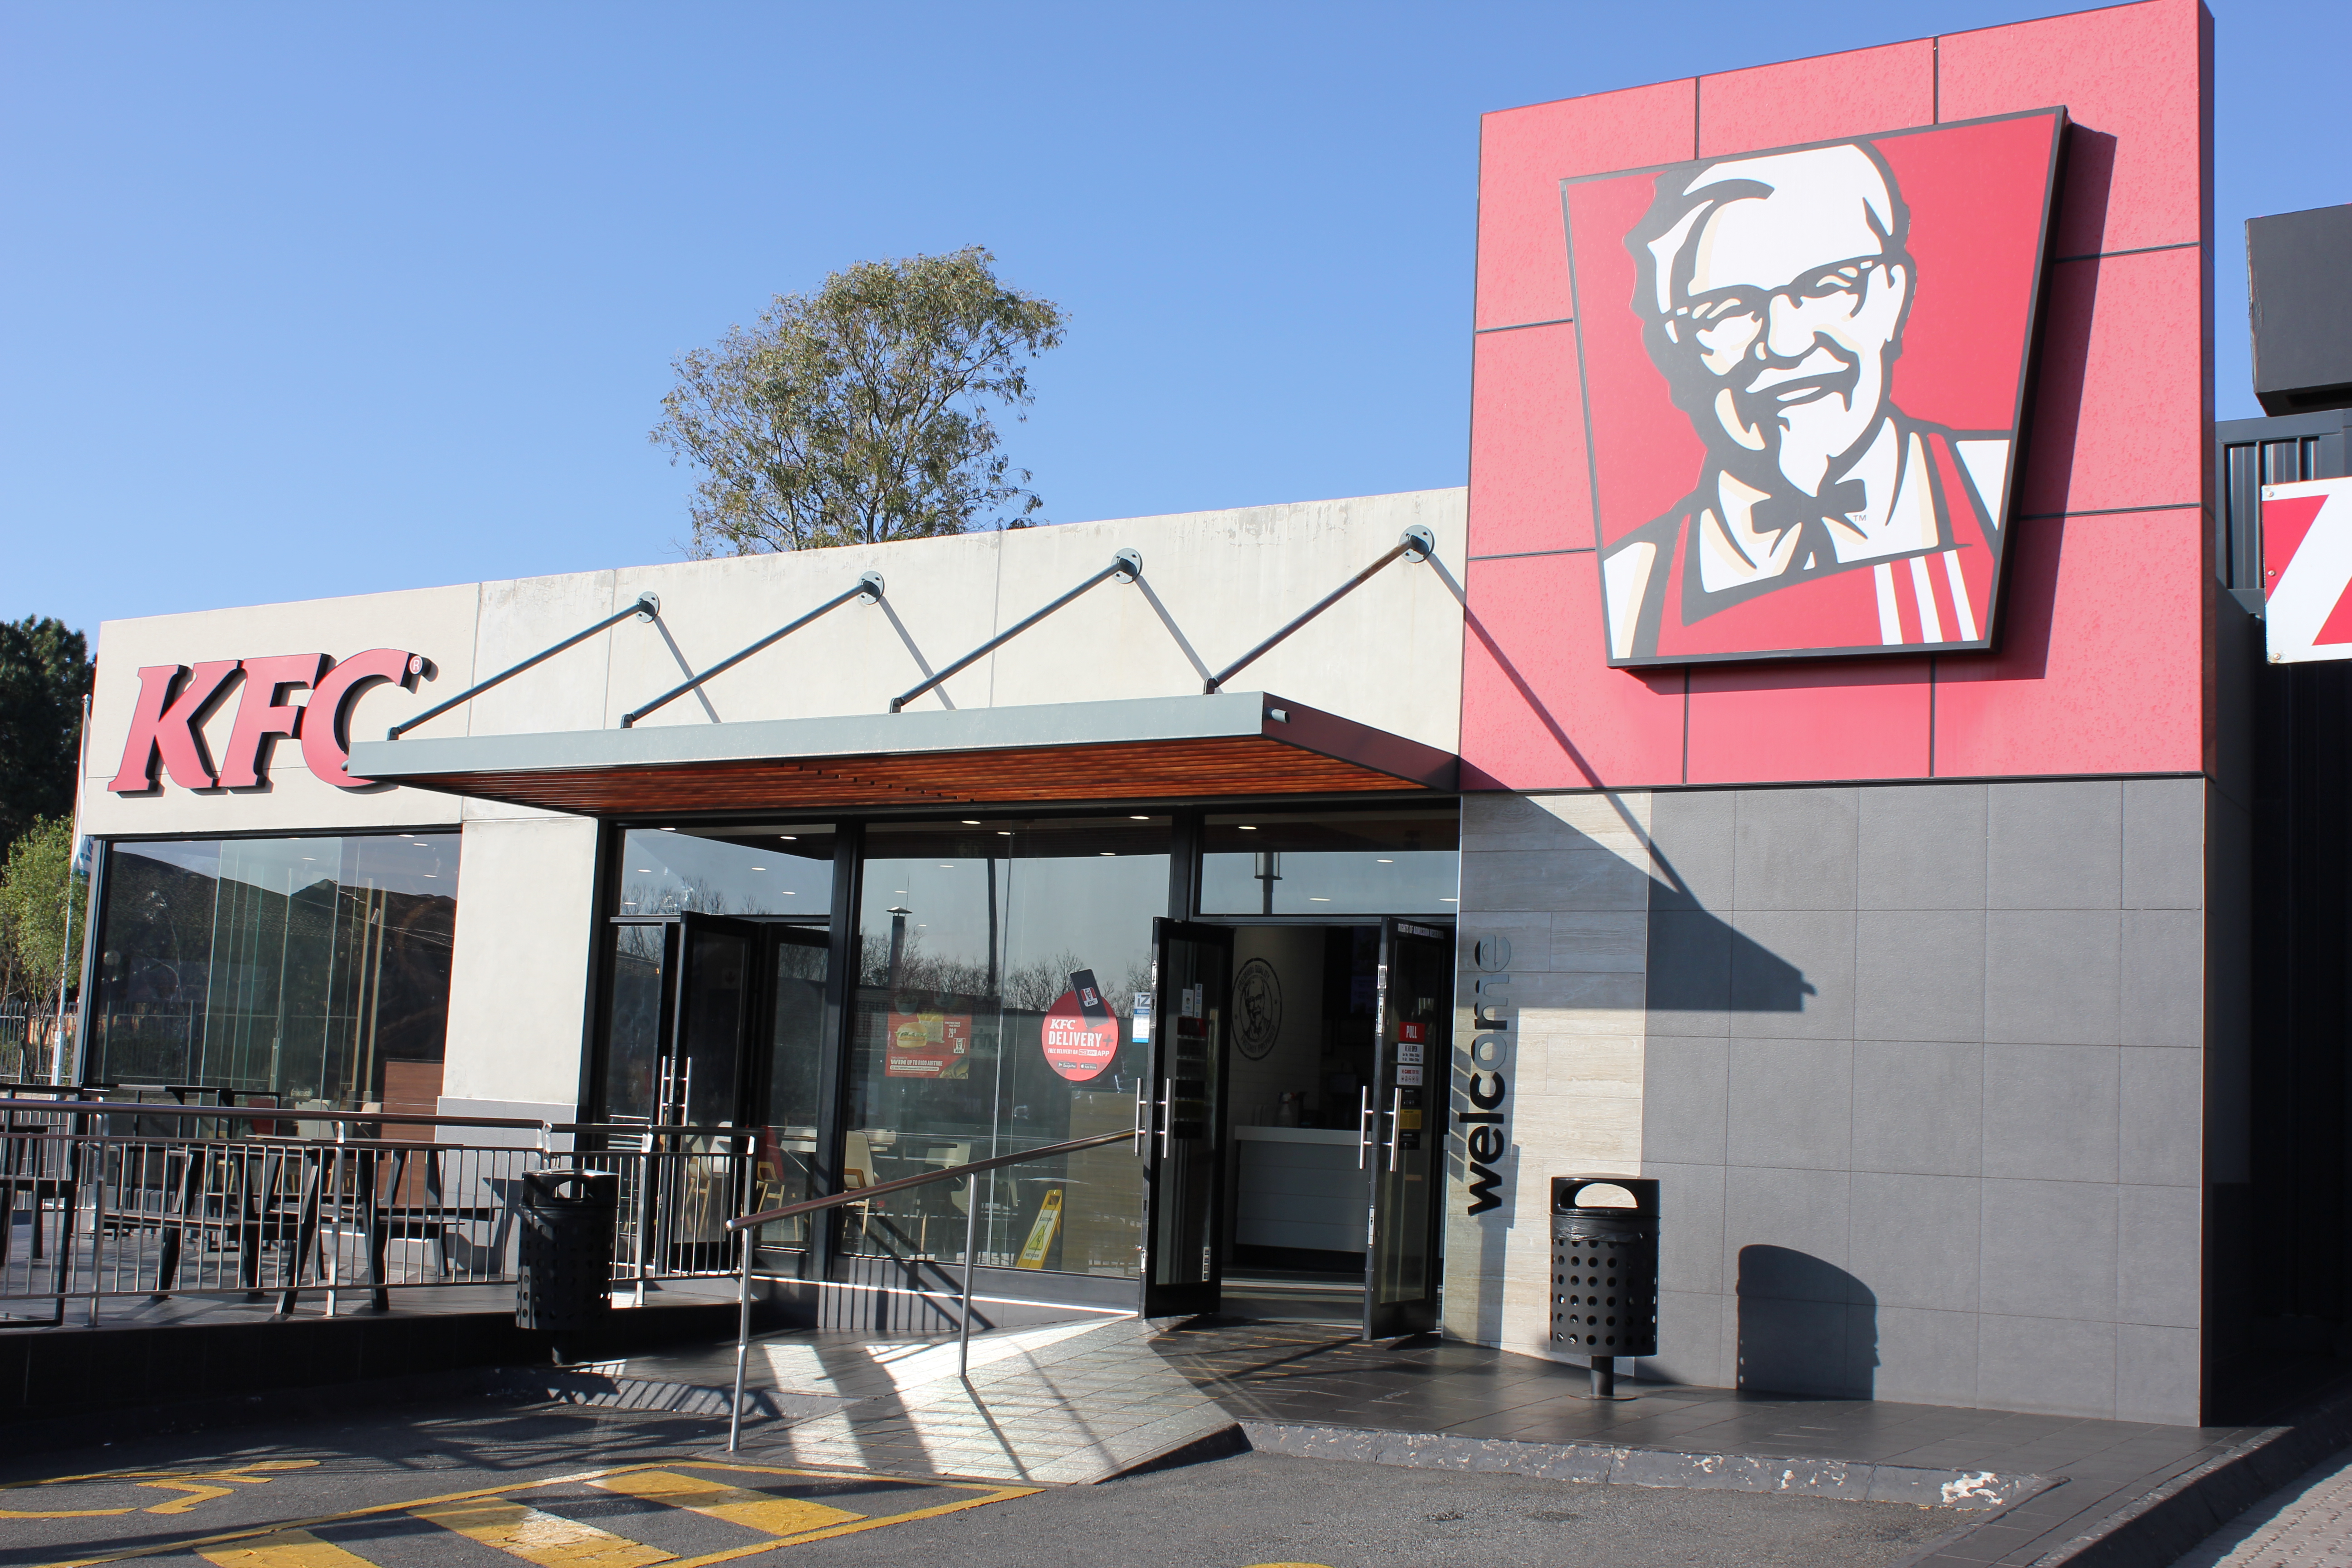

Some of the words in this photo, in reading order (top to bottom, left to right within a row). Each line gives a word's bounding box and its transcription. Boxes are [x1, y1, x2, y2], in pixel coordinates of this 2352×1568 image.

[107, 648, 417, 792] KFC
[1398, 923, 1409, 933] RIGHTS
[1409, 925, 1413, 934] OF
[1413, 926, 1429, 936] ADMISSION
[1049, 1019, 1075, 1029] KFC
[1048, 1031, 1102, 1047] DELIVERY
[1406, 1025, 1417, 1039] PULL
[1459, 935, 1510, 1216] welcome
